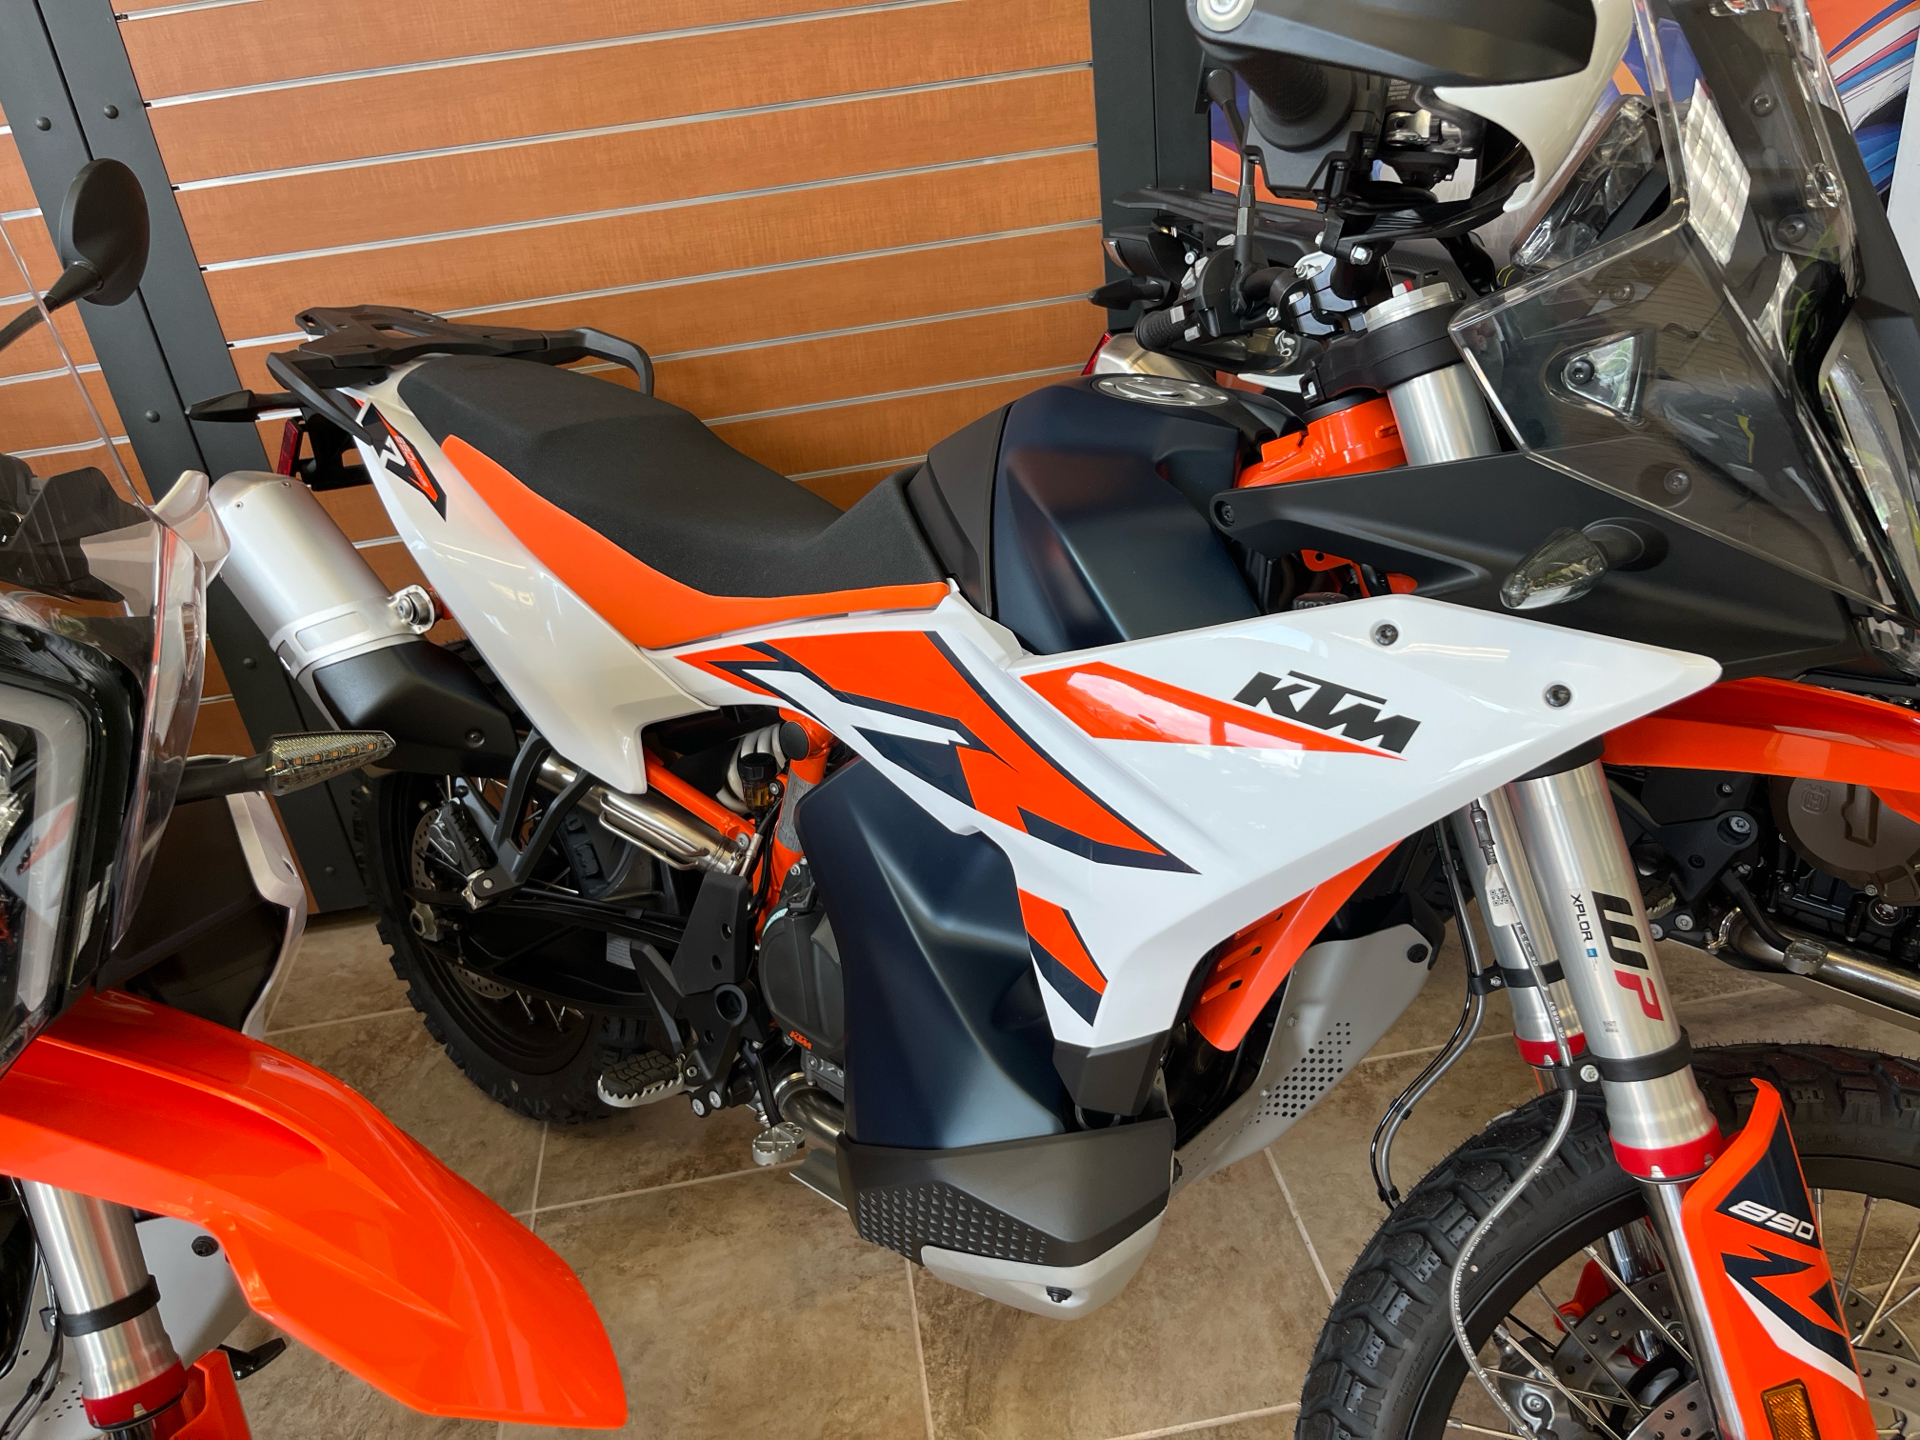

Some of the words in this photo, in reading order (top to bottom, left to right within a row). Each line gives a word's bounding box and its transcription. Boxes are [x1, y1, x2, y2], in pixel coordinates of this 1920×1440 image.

[1232, 670, 1421, 754] KTM
[1570, 893, 1594, 943] XPLOR
[1591, 890, 1664, 1021] WP
[789, 1030, 812, 1050] KTM
[1728, 1200, 1815, 1240] 890
